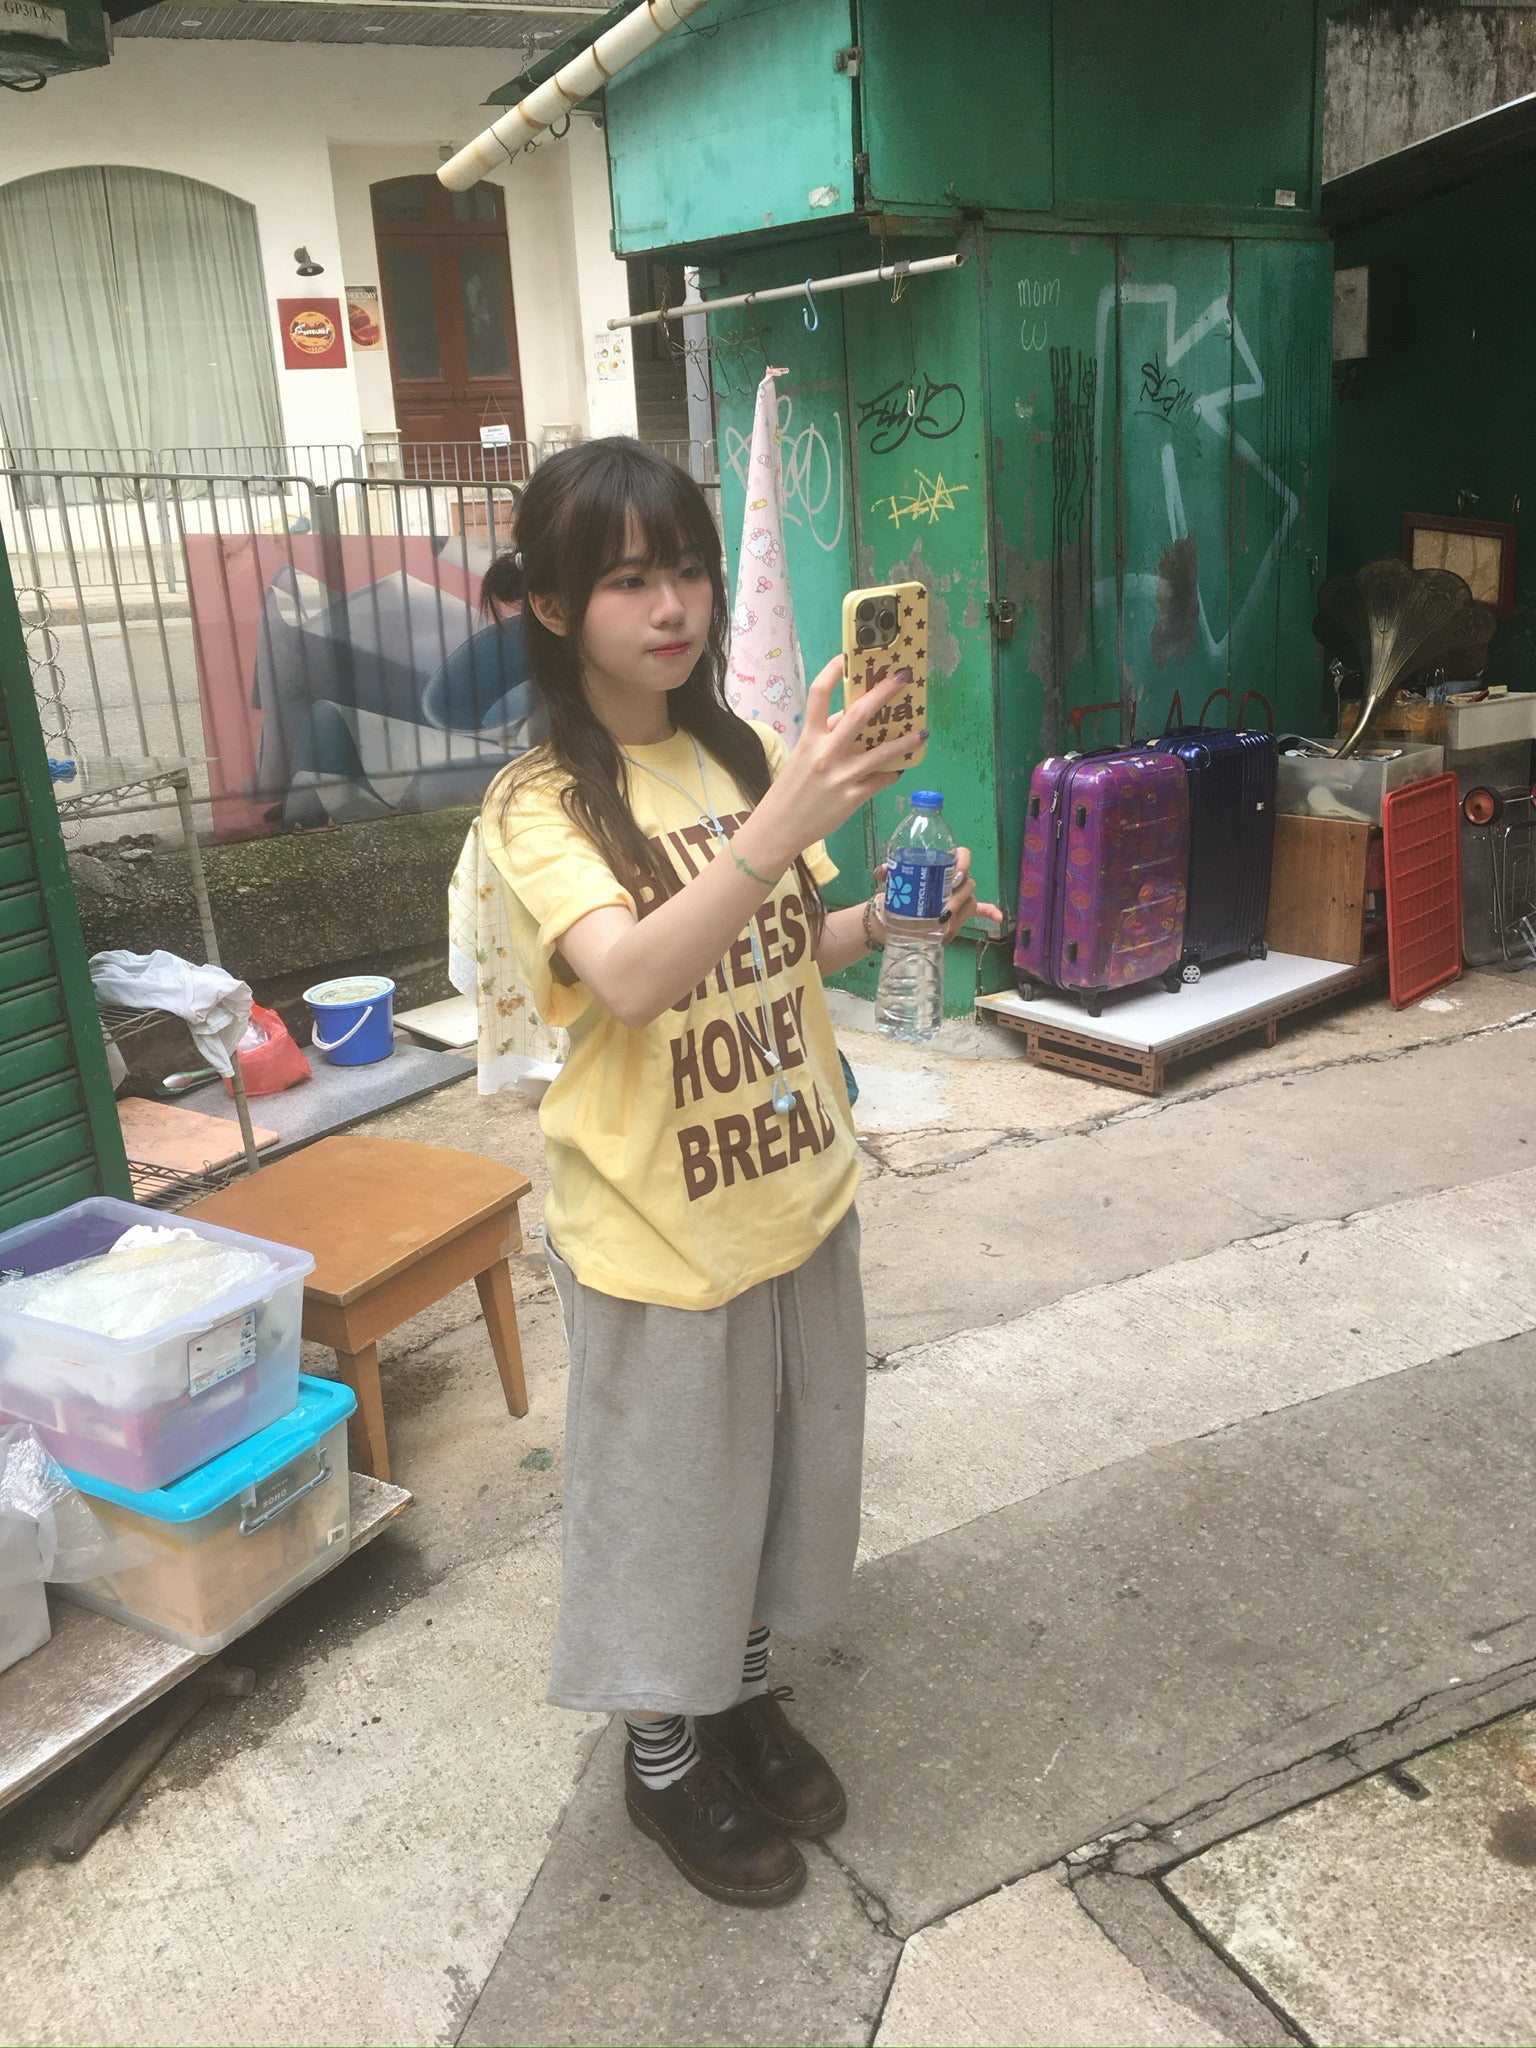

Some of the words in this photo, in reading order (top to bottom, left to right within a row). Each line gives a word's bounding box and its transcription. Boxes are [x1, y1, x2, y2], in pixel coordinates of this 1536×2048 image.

[917, 881, 927, 916] RECYCLE
[920, 866, 928, 880] ME
[670, 986, 807, 1109] HONEY
[677, 1080, 836, 1202] BREAD
